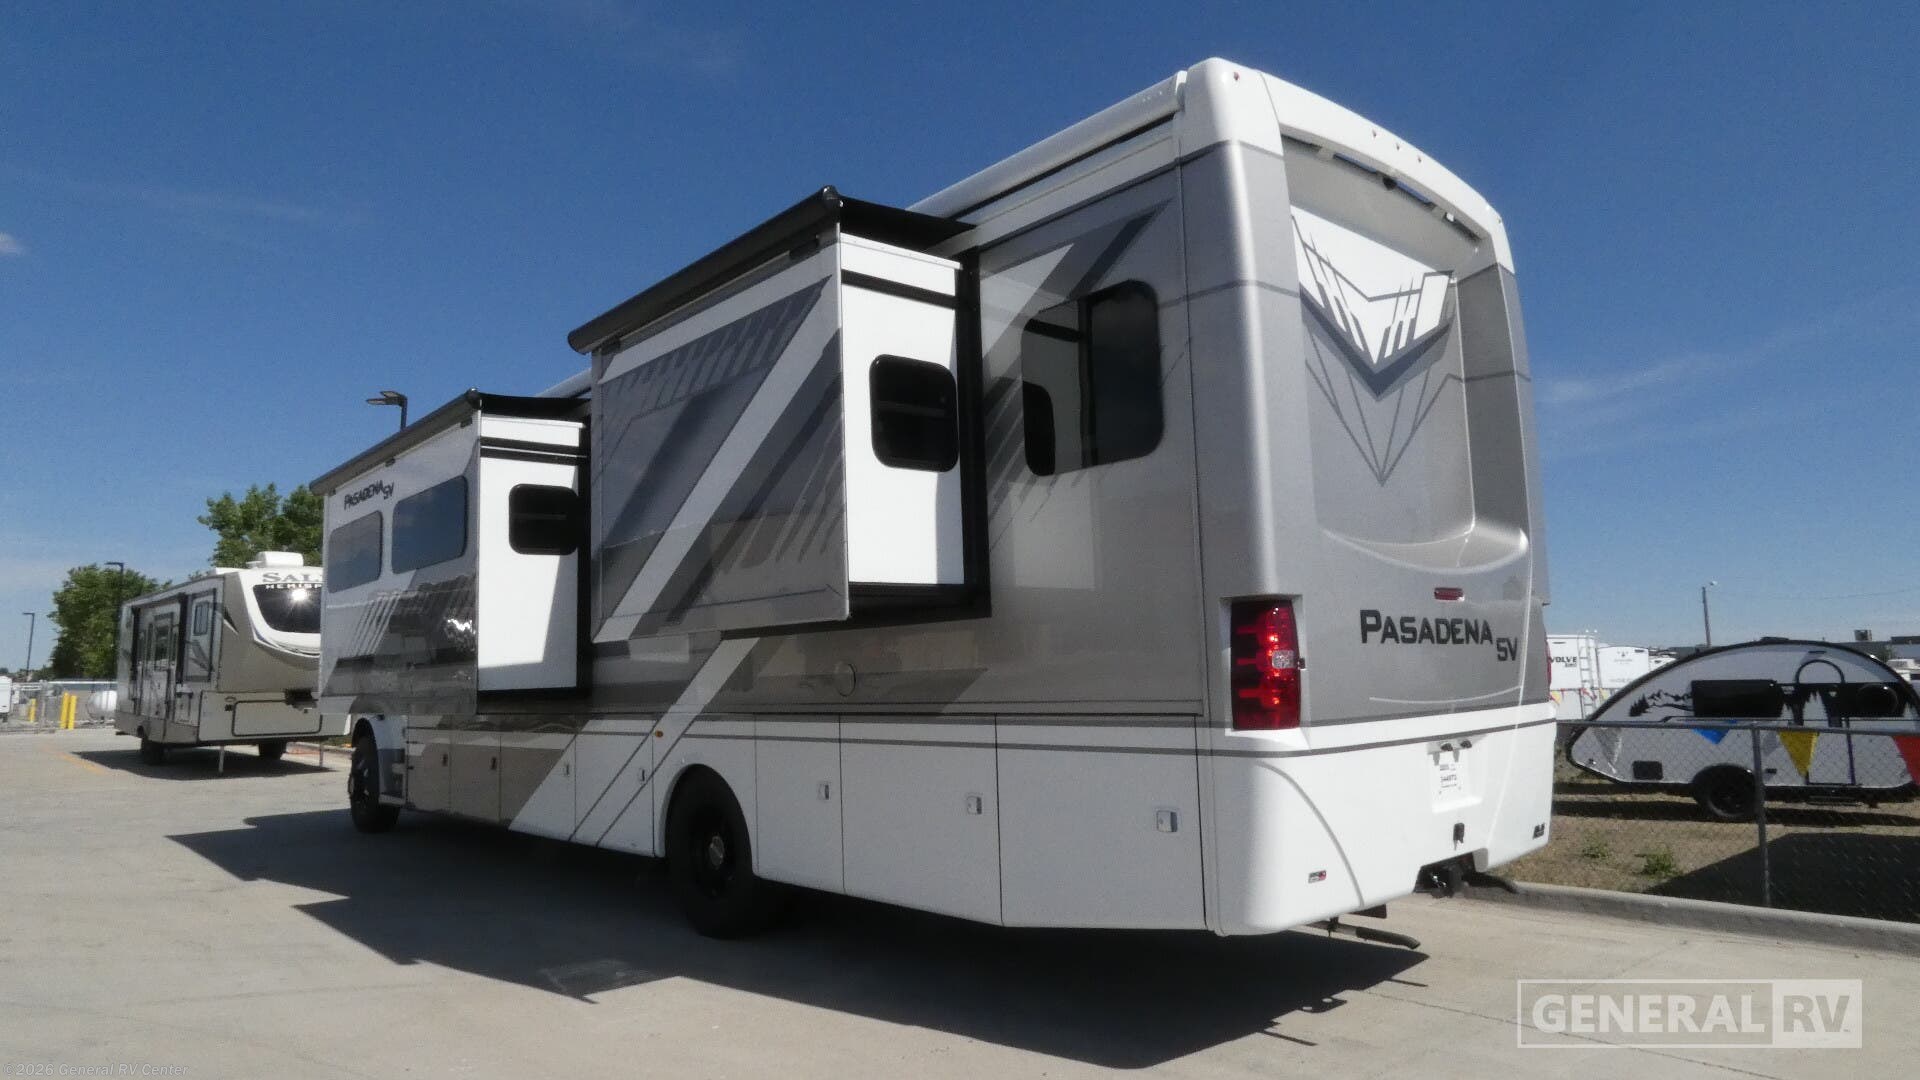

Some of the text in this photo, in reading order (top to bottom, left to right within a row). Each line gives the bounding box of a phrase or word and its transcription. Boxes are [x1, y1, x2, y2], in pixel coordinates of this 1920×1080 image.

[262, 571, 323, 583] SAL
[1360, 609, 1518, 661] PASADENA SV
